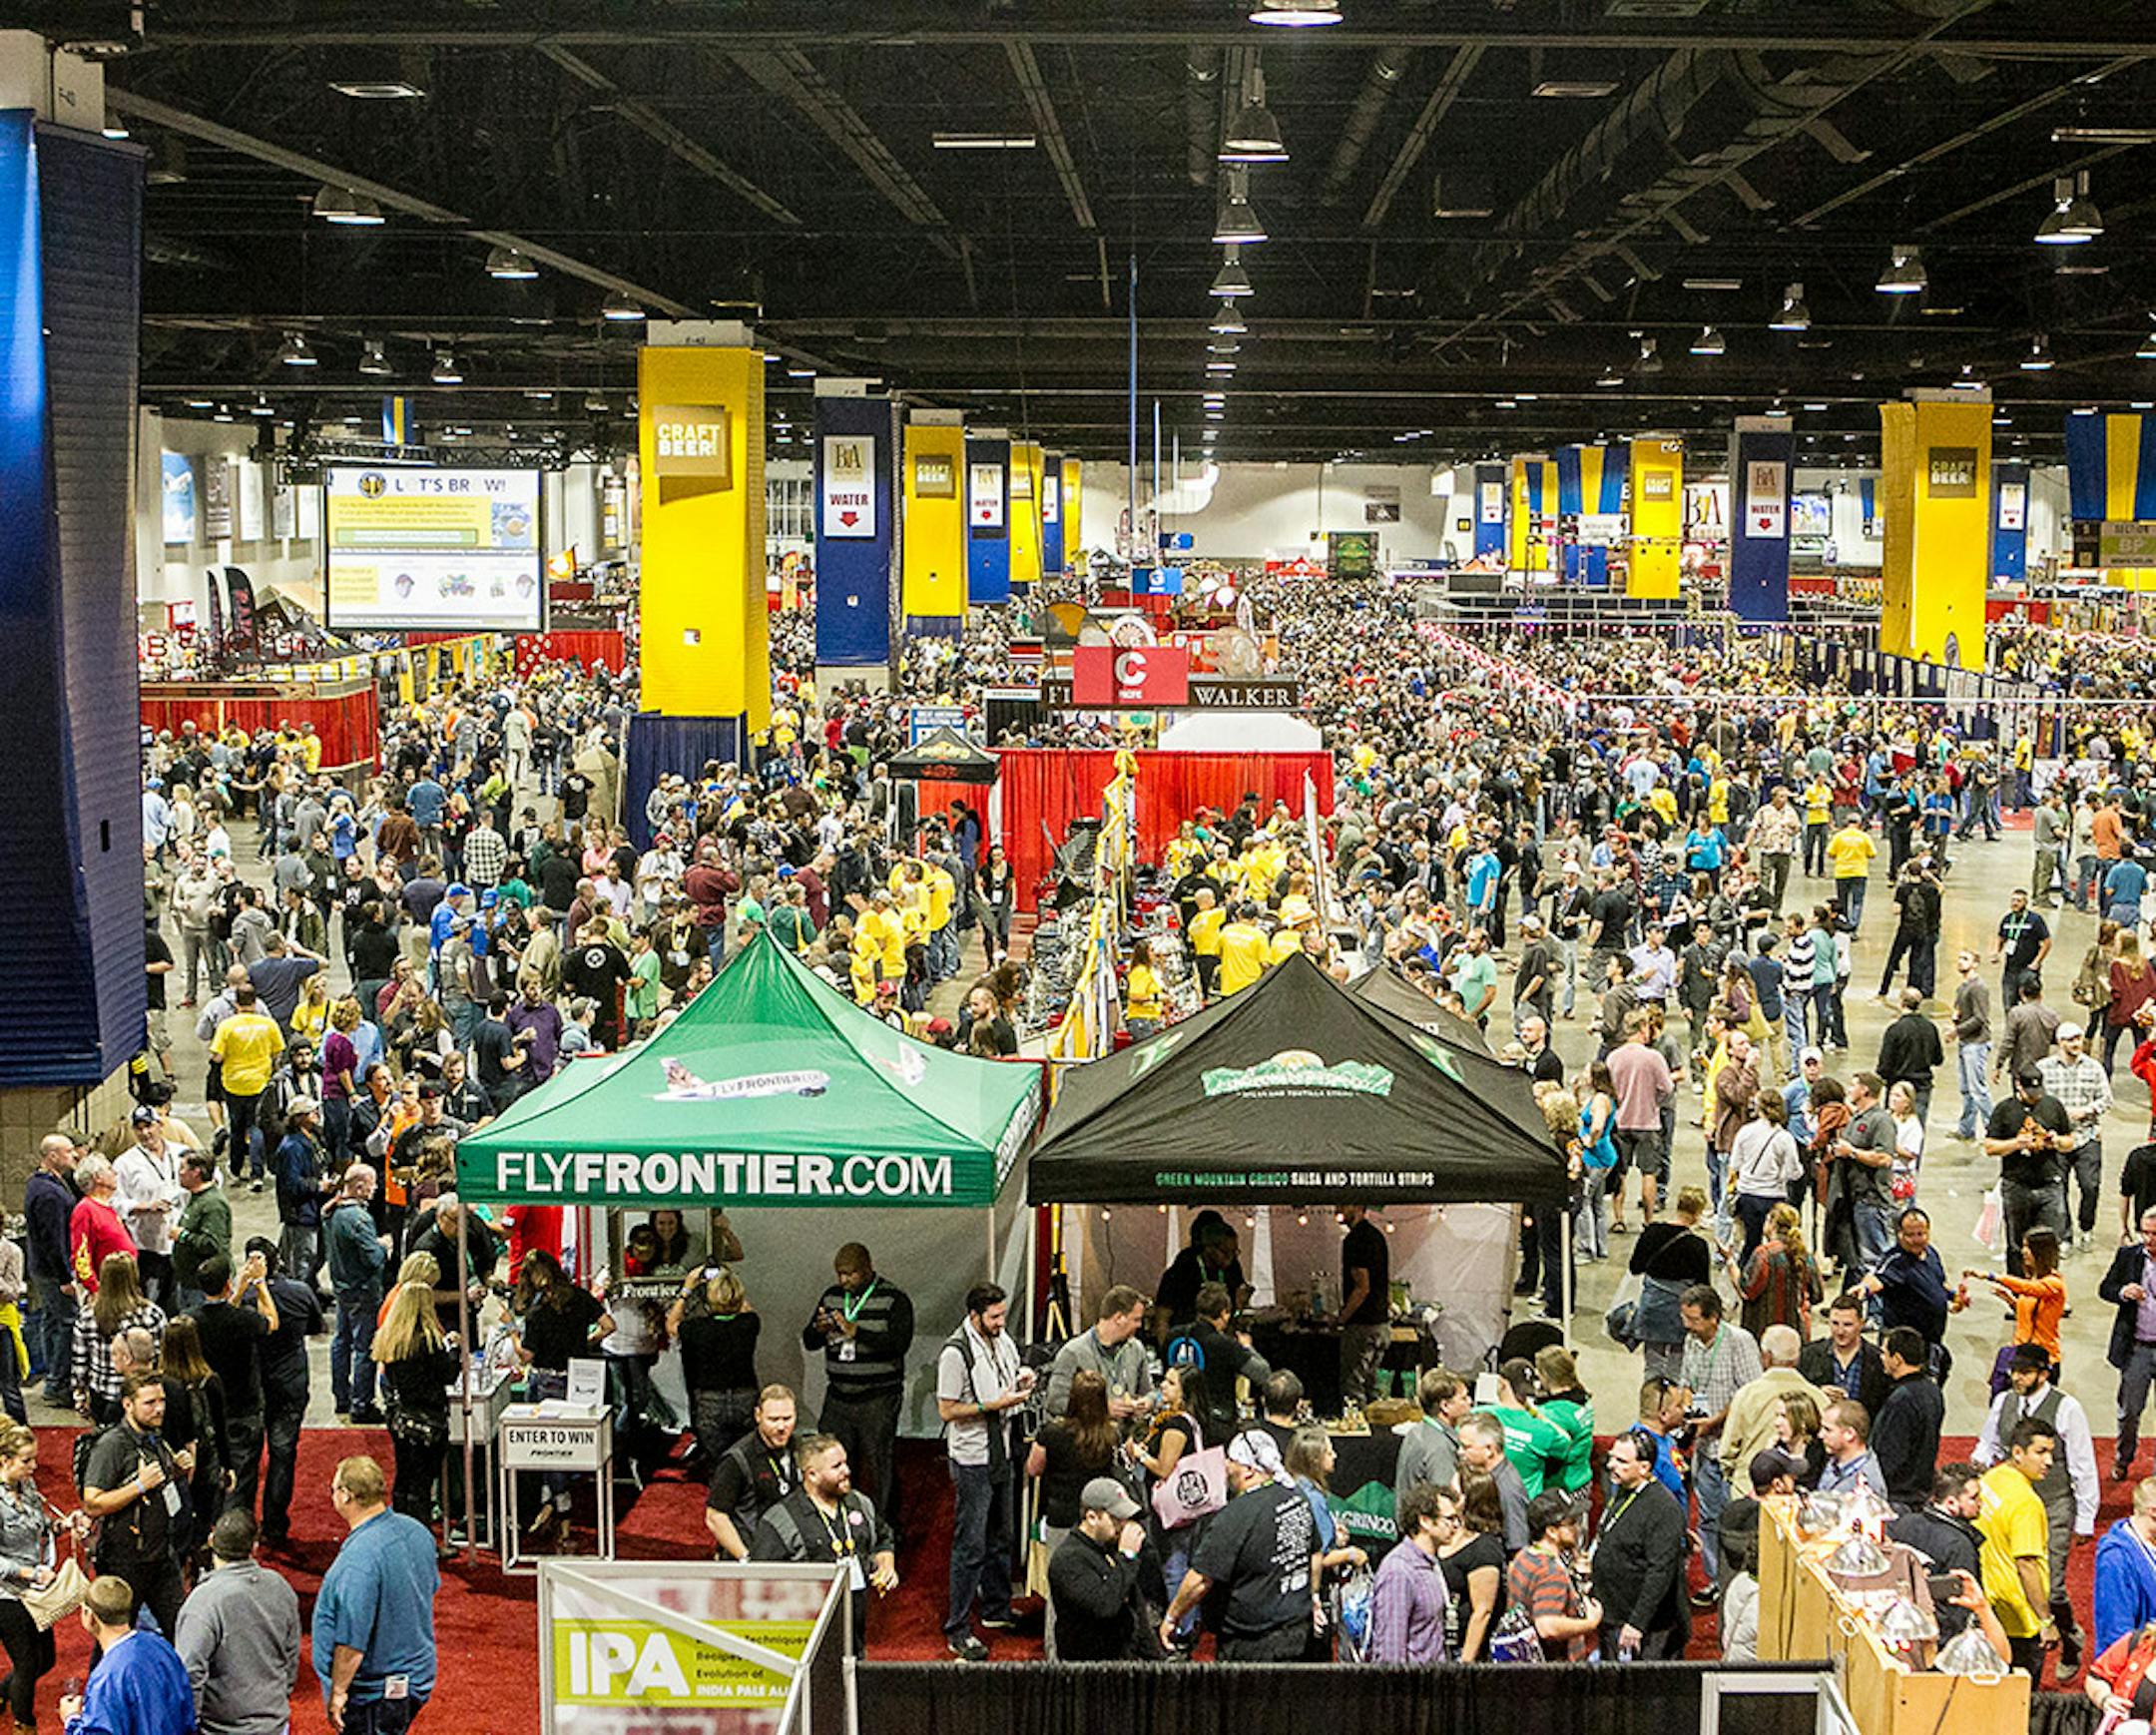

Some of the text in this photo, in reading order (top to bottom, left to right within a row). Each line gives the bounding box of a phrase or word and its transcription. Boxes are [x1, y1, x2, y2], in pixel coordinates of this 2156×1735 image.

[657, 424, 721, 440] CRAFT
[658, 440, 714, 456] BEER
[829, 494, 868, 506] WATER
[1751, 505, 1781, 514] WATER
[1114, 651, 1148, 687] C
[1194, 686, 1293, 707] WALKER
[497, 1152, 953, 1196] FLYFRONTIER.COM
[1155, 1172, 1191, 1186] GREEN
[1194, 1172, 1247, 1186] MOUNTAIN
[1291, 1172, 1323, 1186] SALSA
[1325, 1172, 1348, 1186] AND
[1348, 1172, 1395, 1186] TORTILLA
[1397, 1172, 1435, 1187] STRIPS
[509, 1430, 594, 1446] ENTER TO WIN
[569, 1631, 691, 1696] IPA
[696, 1668, 764, 1679] Evolution of
[696, 1685, 734, 1697] INDIA
[736, 1684, 766, 1697] PALE
